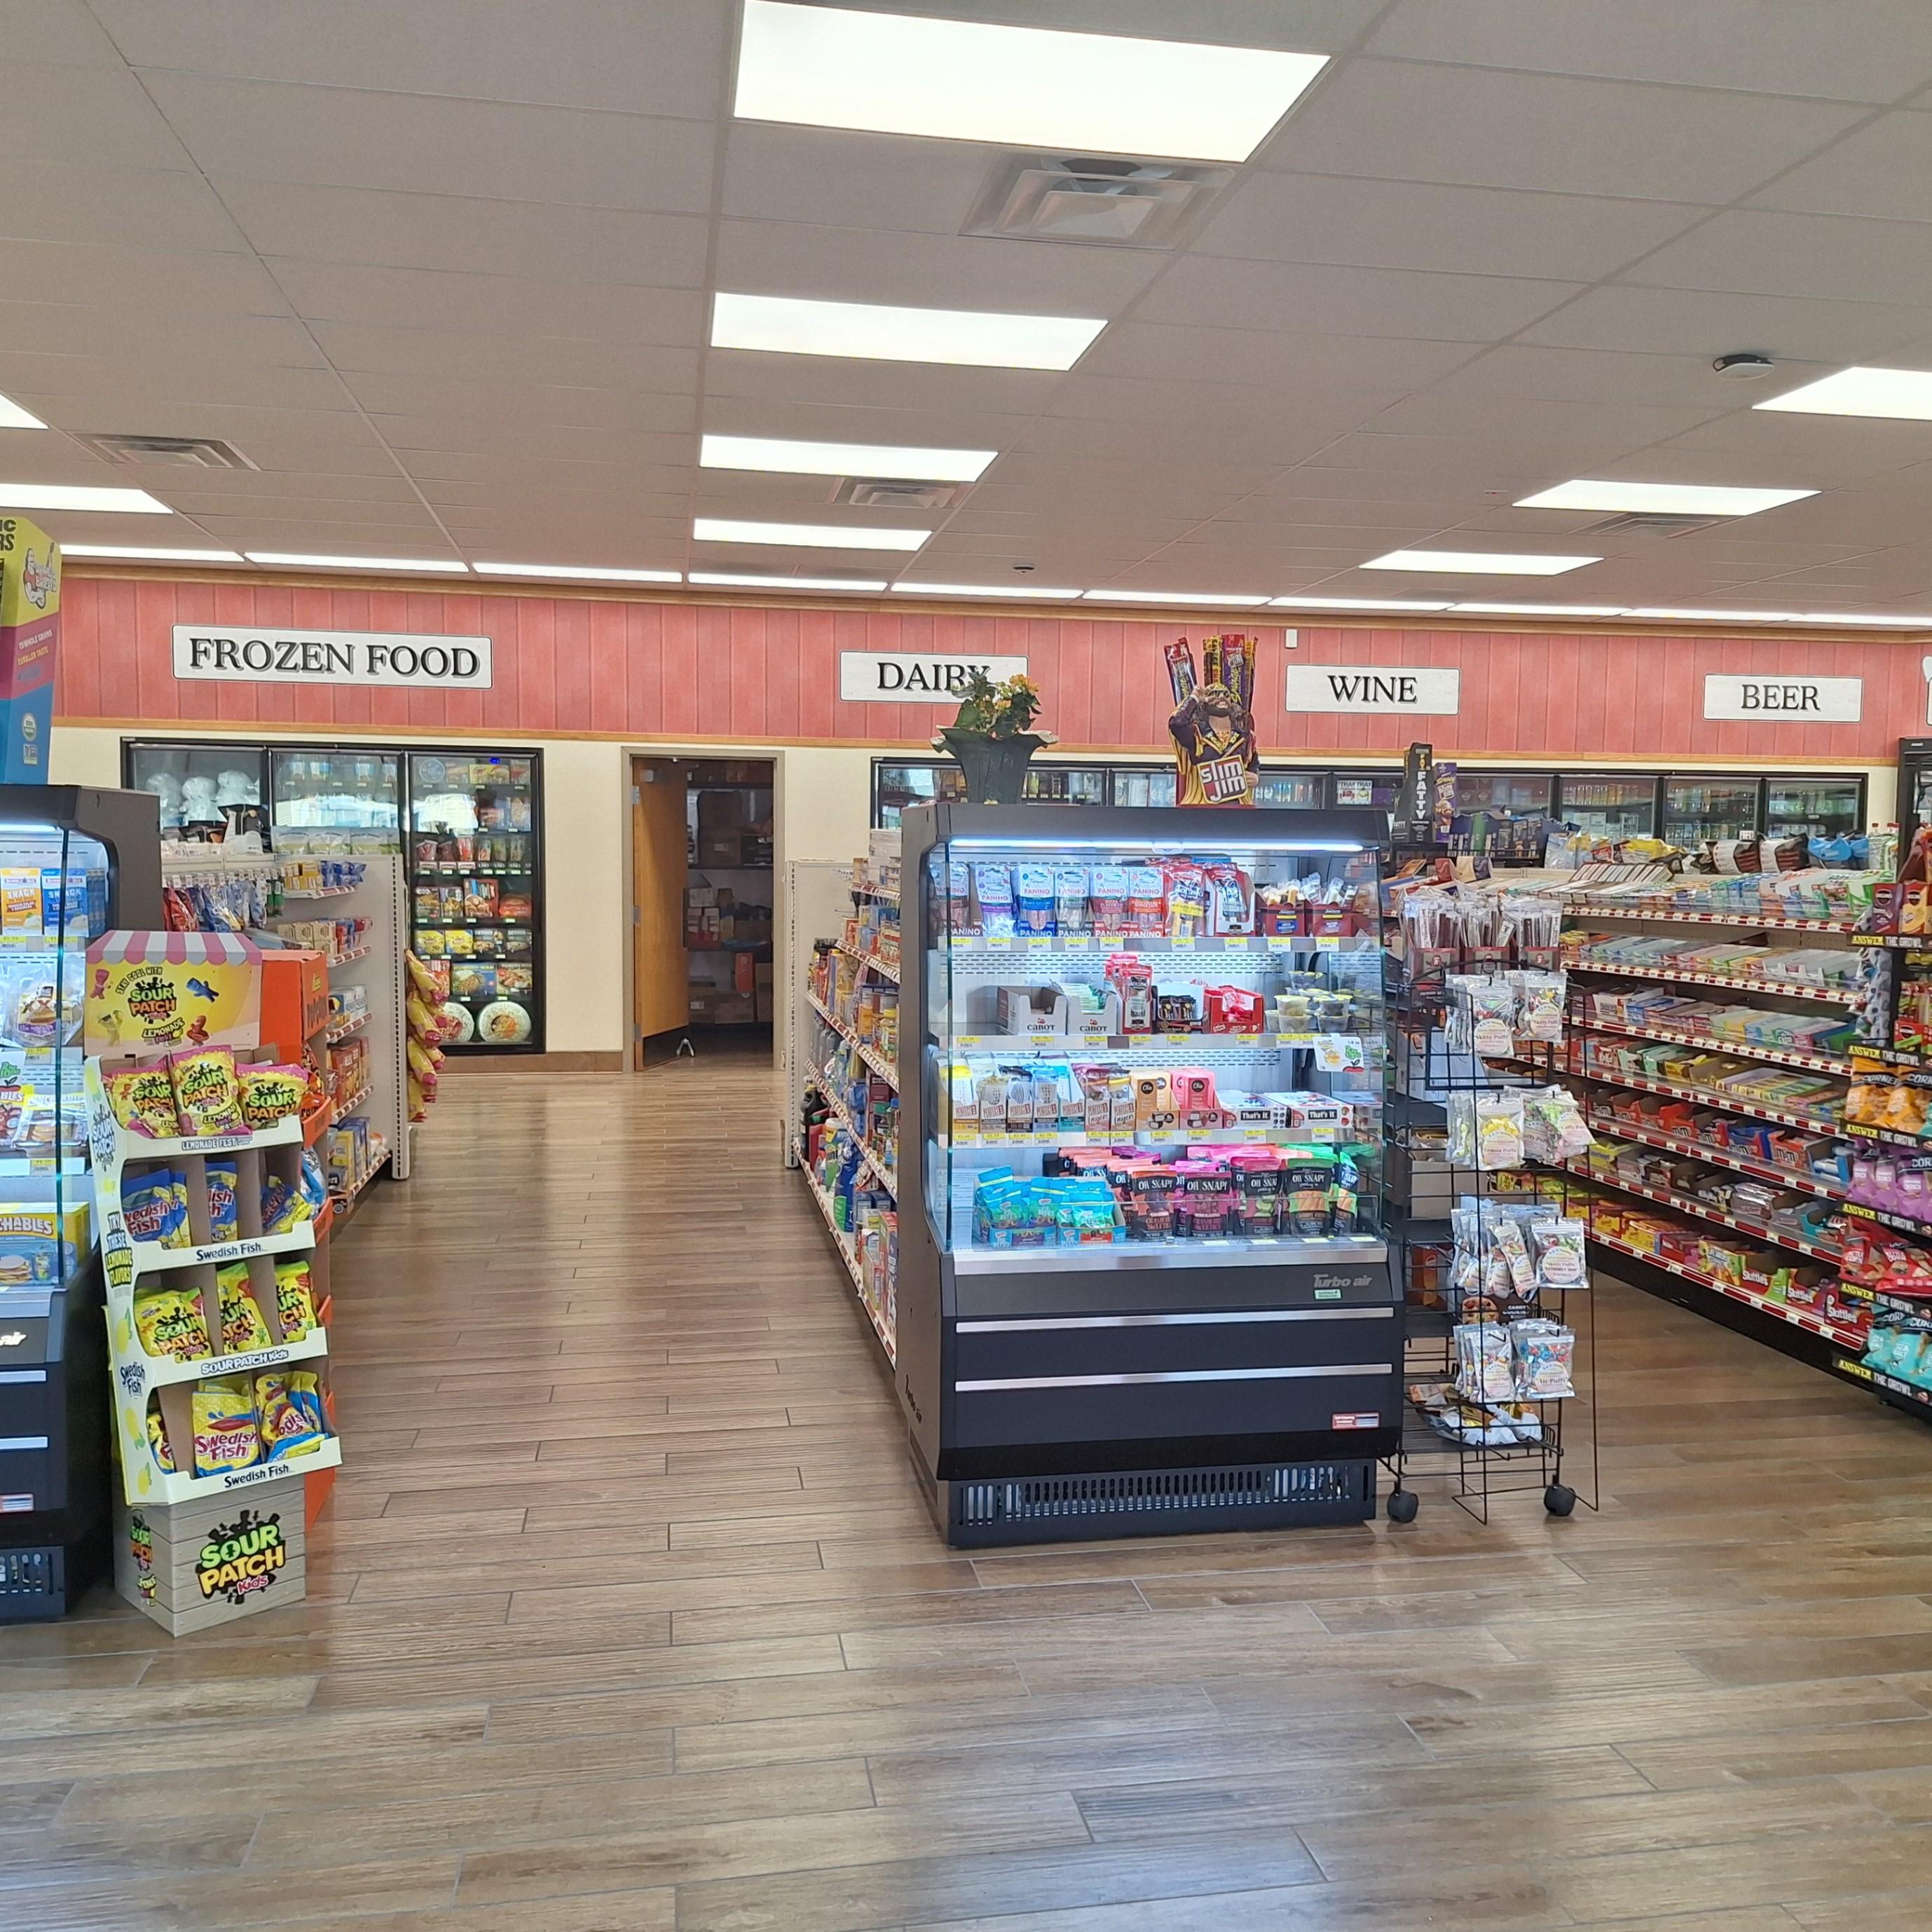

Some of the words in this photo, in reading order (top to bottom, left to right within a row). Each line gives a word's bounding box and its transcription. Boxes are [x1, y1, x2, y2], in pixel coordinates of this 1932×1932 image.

[189, 637, 353, 675] FROZEN
[366, 644, 481, 678] FOOD
[1327, 675, 1418, 704] WINE
[1741, 684, 1822, 712] BEER
[1415, 771, 1427, 819] FATTY
[7, 888, 35, 900] SNACK
[1851, 935, 1884, 946] ANSWER
[1886, 936, 1898, 947] THE
[1899, 937, 1923, 948] GROWL
[116, 980, 130, 994] STAY
[128, 968, 146, 982] COOL
[146, 966, 163, 975] WITH
[131, 987, 173, 1002] SOUR
[130, 999, 175, 1015] PATCH
[142, 1018, 184, 1038] LEMONADE
[1848, 1045, 1881, 1060] ANSWER
[1882, 1050, 1896, 1062] THE
[1896, 1053, 1920, 1067] GROWL
[133, 1084, 172, 1098] SOUR
[184, 1071, 225, 1094] SOUR
[182, 1083, 228, 1107] PATCH
[248, 1091, 294, 1107] SOUR
[1242, 1111, 1261, 1120] That's
[1309, 1111, 1329, 1119] That's
[92, 1119, 114, 1138] SOUR
[1845, 1123, 1879, 1139] ANSWER
[1879, 1130, 1893, 1142] THE
[1893, 1133, 1919, 1149] GROWL
[181, 1139, 218, 1151] LEMONADE
[218, 1137, 237, 1148] FEST
[1138, 1180, 1149, 1191] OH
[1186, 1181, 1199, 1191] OH
[107, 1212, 121, 1231] TRY
[124, 1200, 169, 1224] wedish
[1842, 1203, 1876, 1221] ANSWER
[1877, 1212, 1891, 1224] THE
[1891, 1215, 1917, 1233] GROWL
[128, 1217, 161, 1235] Fish
[107, 1233, 127, 1251] THESE
[196, 1247, 238, 1261] Swedish
[240, 1242, 262, 1254] Fish
[106, 1249, 133, 1270] LEMONADE
[108, 1268, 132, 1288] FLAVORS
[1313, 1274, 1351, 1288] Turbo
[1353, 1275, 1372, 1287] air
[1742, 1270, 1769, 1286] Skittles
[1788, 1287, 1814, 1304] Skittles
[1841, 1282, 1875, 1301] ANSWER
[1876, 1292, 1890, 1306] THE
[1891, 1297, 1915, 1315] GROWL
[1827, 1306, 1858, 1324] Skittles
[200, 1357, 235, 1375] SOUR
[235, 1353, 268, 1370] PATCH
[268, 1350, 289, 1360] Kids
[120, 1362, 146, 1385] Swedish
[1839, 1359, 1872, 1381] ANSWER
[1873, 1372, 1888, 1387] THE
[1888, 1376, 1913, 1397] GROWL
[127, 1378, 142, 1395] Fish
[194, 1431, 259, 1452] Swedish
[210, 1444, 249, 1462] Fish
[224, 1469, 266, 1487] Swedish
[268, 1464, 289, 1478] Fish
[201, 1524, 278, 1569] SOUR
[199, 1545, 285, 1595] PATCH
[237, 1574, 269, 1596] Kids
